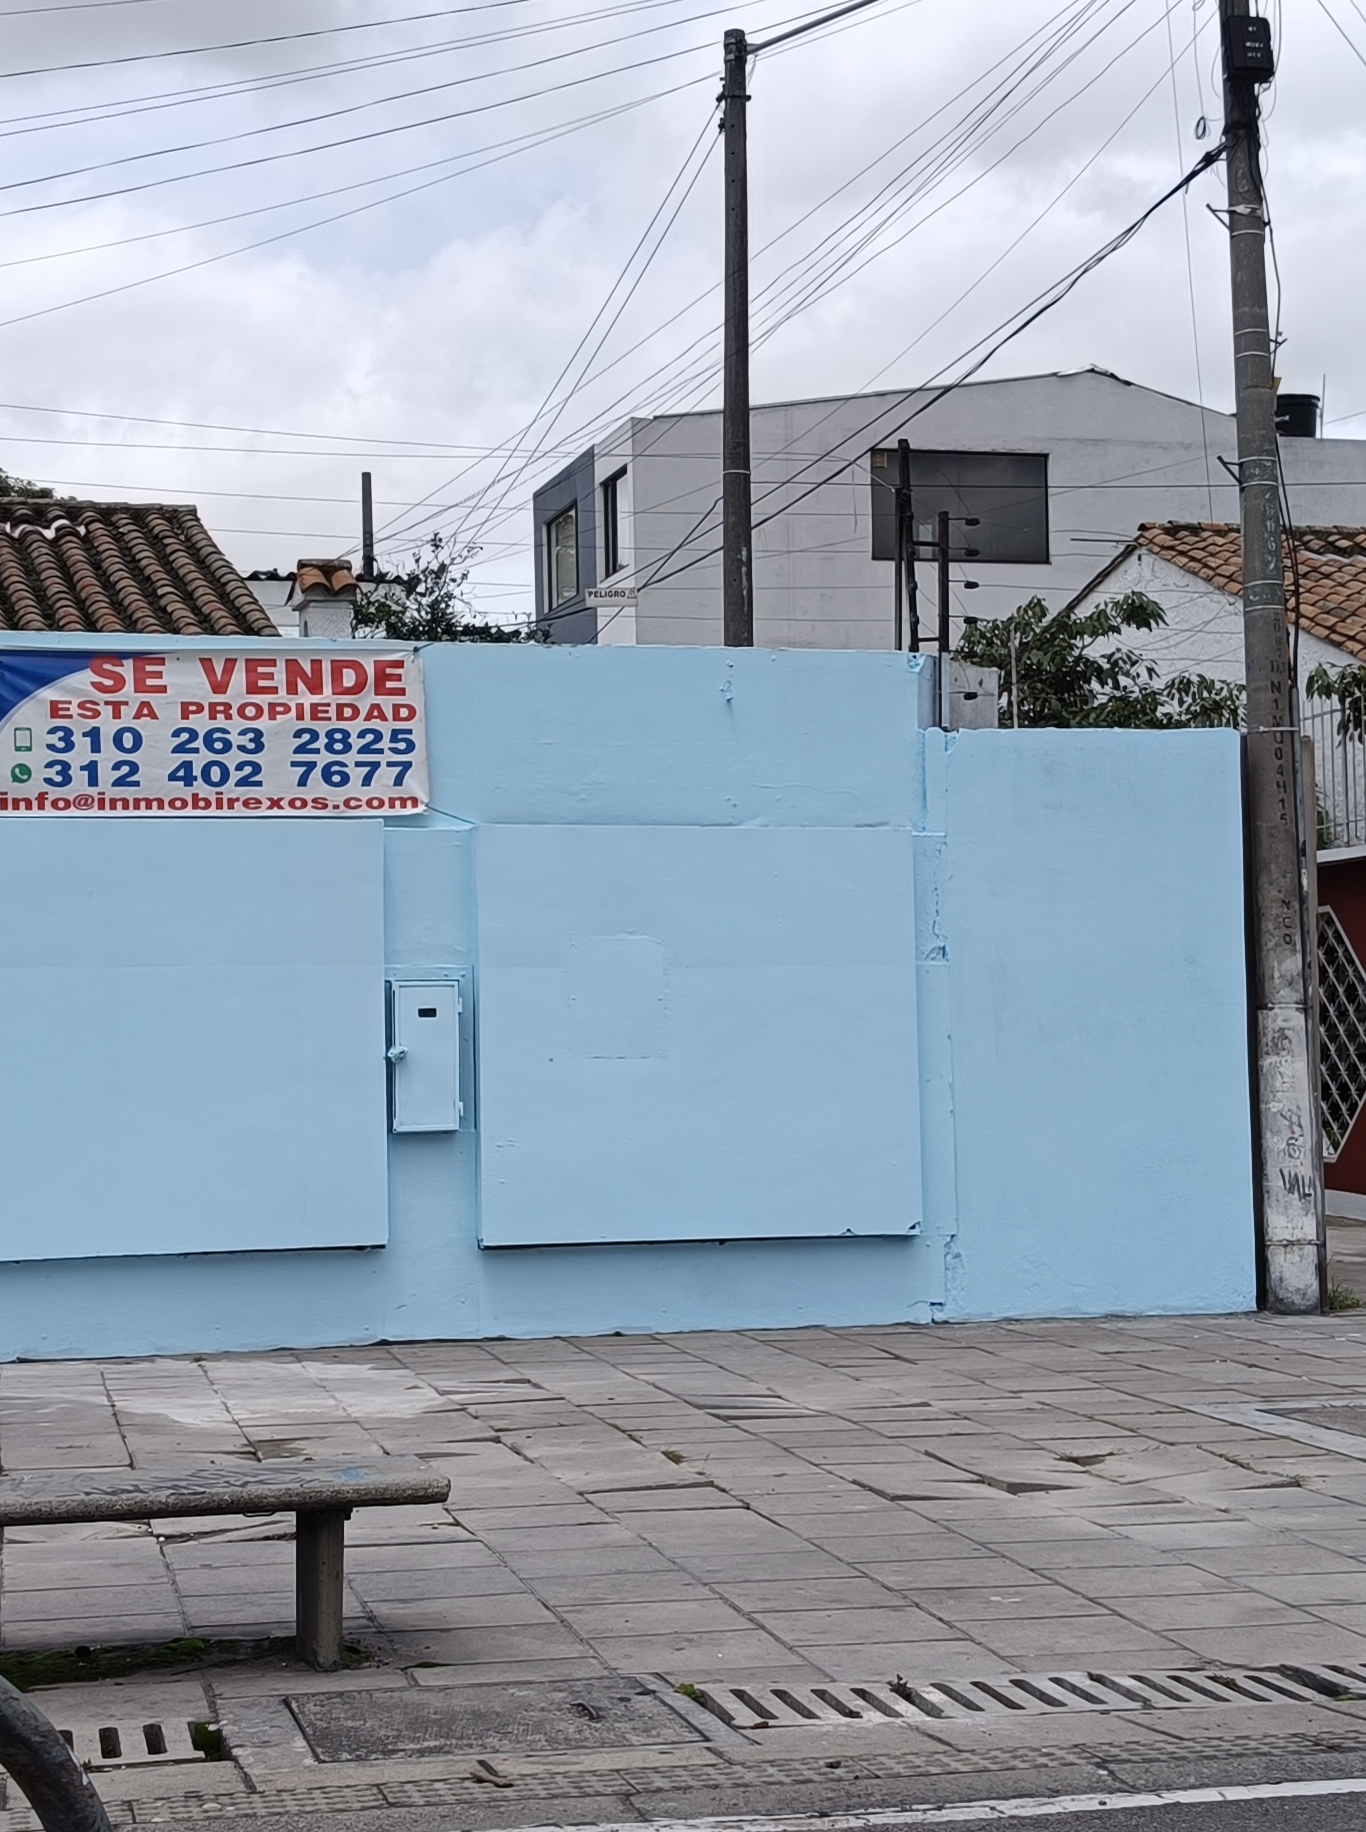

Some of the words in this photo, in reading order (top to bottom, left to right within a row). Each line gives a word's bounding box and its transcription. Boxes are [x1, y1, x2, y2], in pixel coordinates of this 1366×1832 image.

[588, 590, 625, 598] PELIGRO
[89, 656, 168, 694] SE
[199, 658, 407, 697] VENDE
[49, 700, 159, 720] ESTA
[180, 701, 417, 722] PROPIEDAD
[45, 726, 143, 754] 310
[170, 726, 265, 755] 263
[292, 727, 416, 755] 2825
[43, 759, 141, 788] 312
[167, 760, 263, 788] 402
[290, 760, 413, 788] 7677
[0, 791, 419, 811] info@inmobirexos.com
